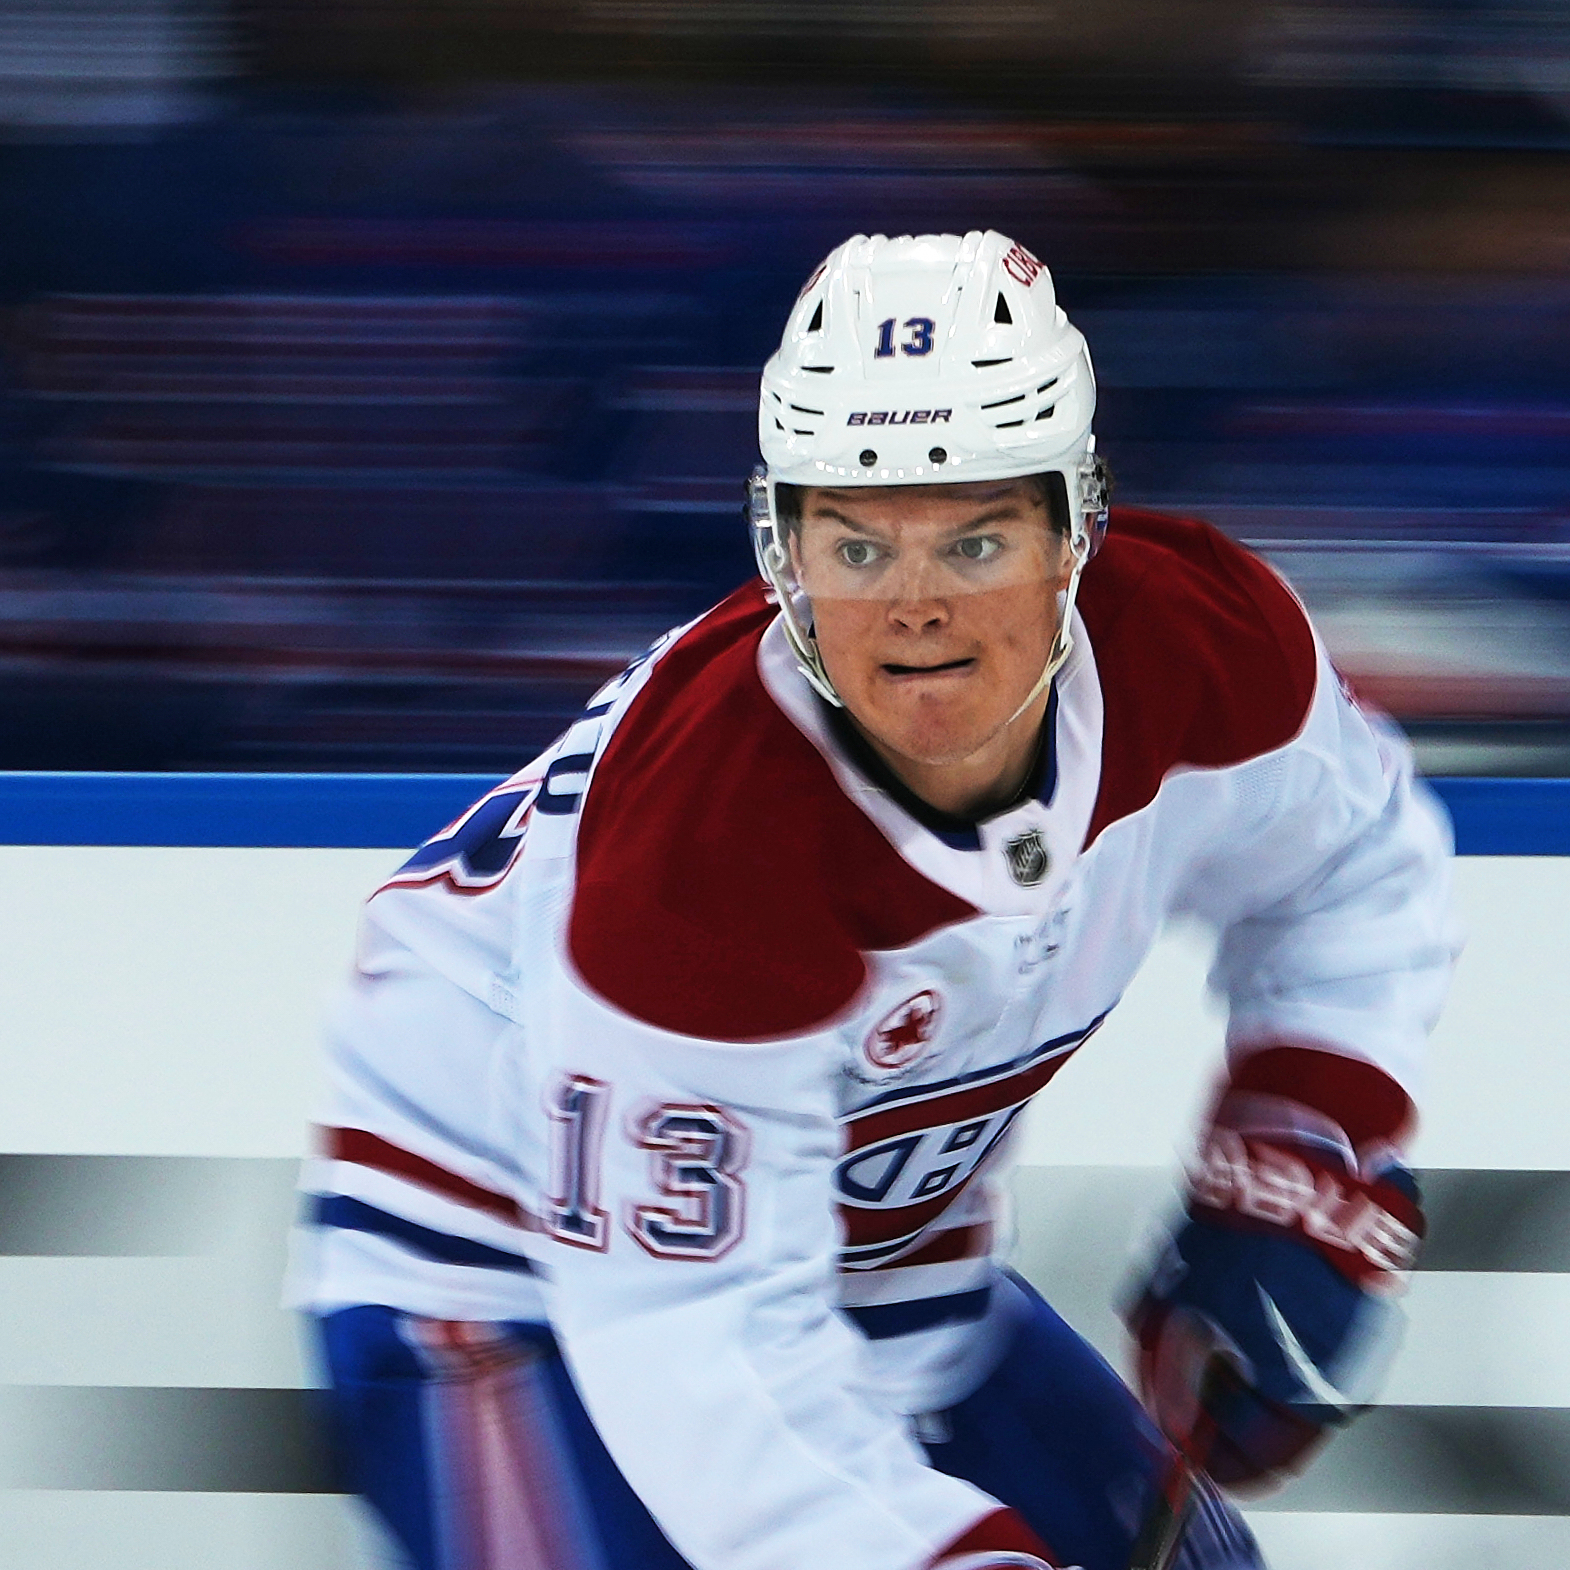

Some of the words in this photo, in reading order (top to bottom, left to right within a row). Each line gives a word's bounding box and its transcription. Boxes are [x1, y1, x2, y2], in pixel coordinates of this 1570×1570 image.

[874, 317, 936, 359] 13
[847, 408, 952, 426] BAUER
[541, 1070, 752, 1262] 13
